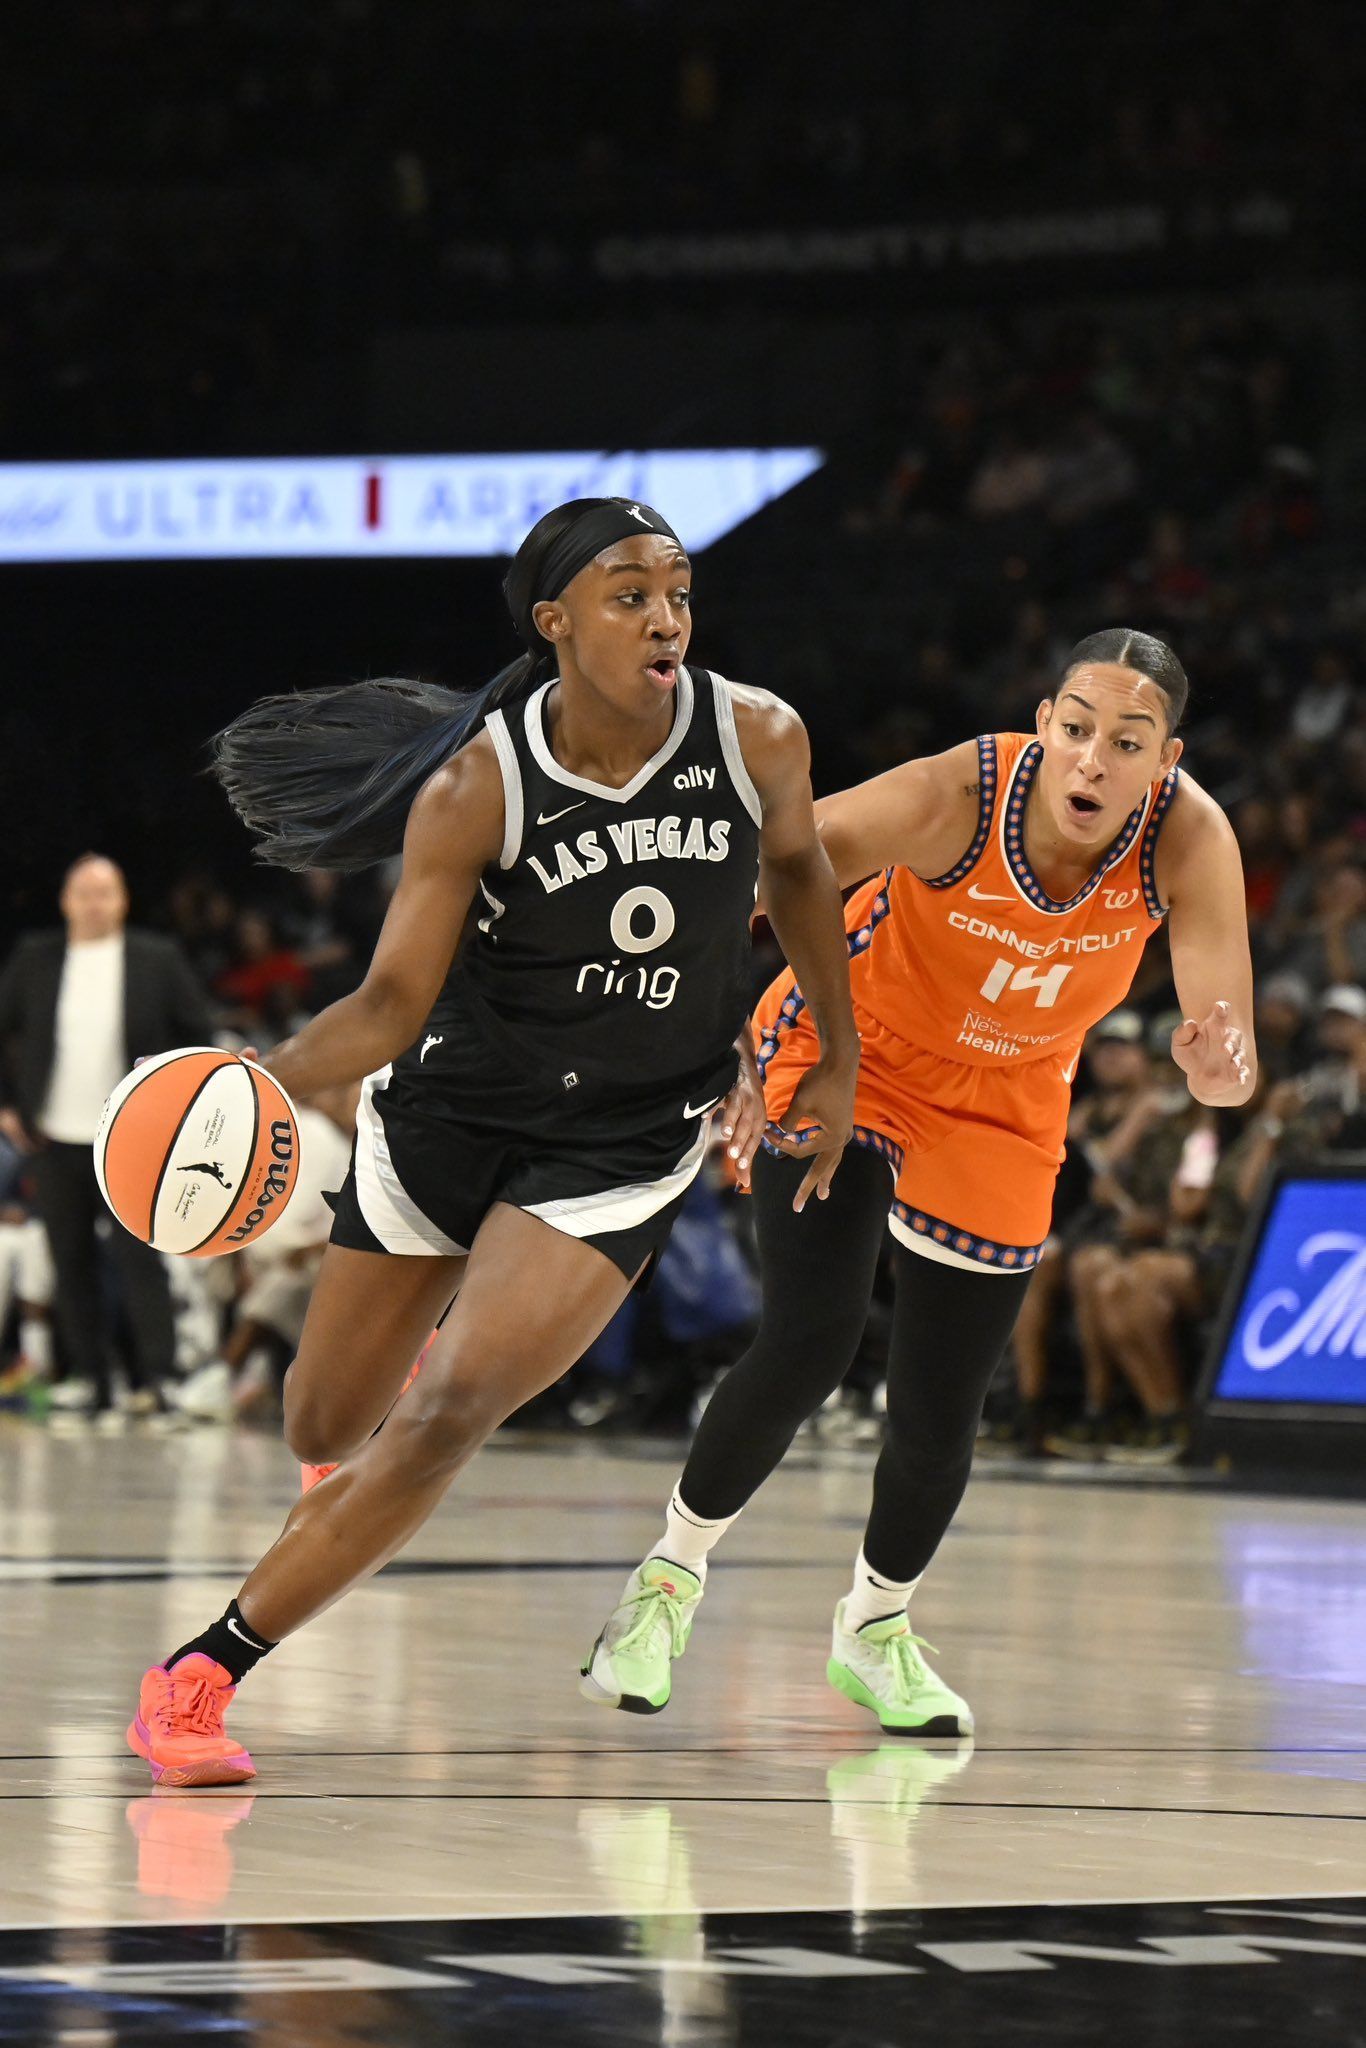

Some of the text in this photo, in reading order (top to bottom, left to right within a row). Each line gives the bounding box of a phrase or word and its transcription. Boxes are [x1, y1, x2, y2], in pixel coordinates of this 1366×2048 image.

[93, 474, 331, 540] ULTRA
[673, 765, 717, 790] ally
[526, 815, 732, 894] LAS VEGAS
[610, 885, 676, 954] 0
[947, 911, 1138, 960] CONNECTICUT
[576, 959, 681, 1009] ring
[979, 957, 1074, 1008] 14
[956, 1031, 1021, 1056] Health
[963, 1012, 1003, 1037] New
[225, 1118, 293, 1242] Wilson
